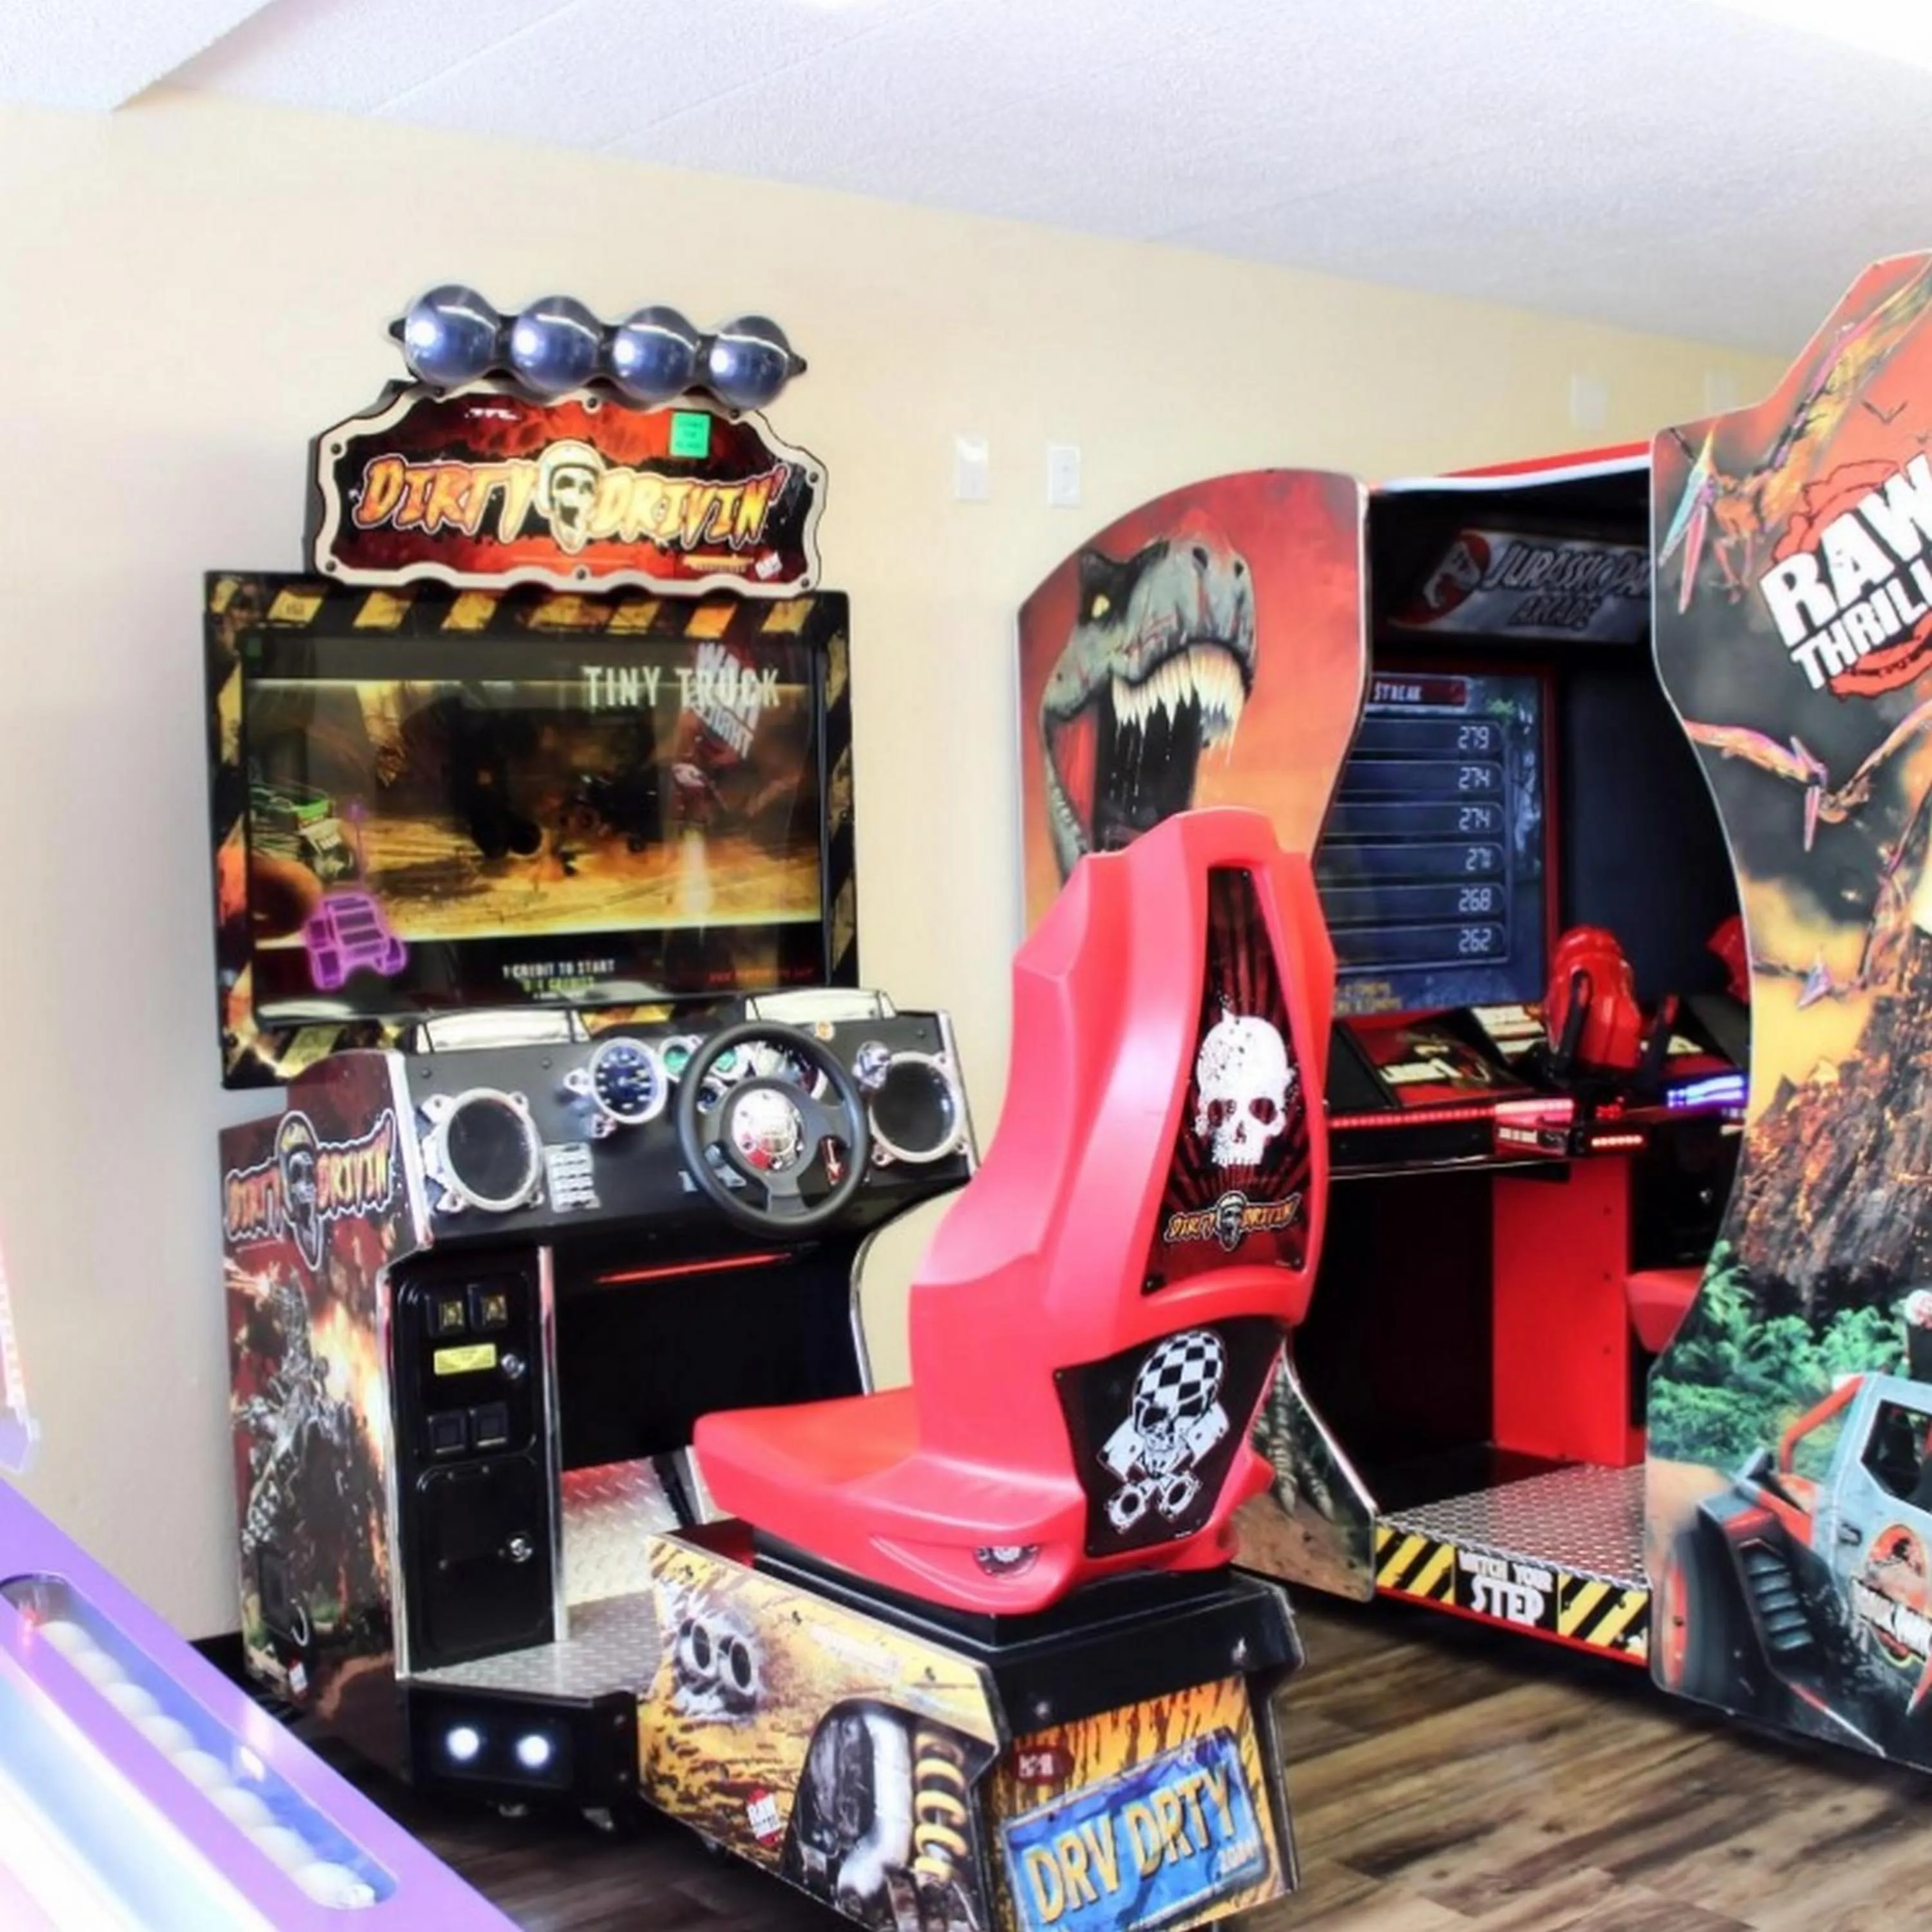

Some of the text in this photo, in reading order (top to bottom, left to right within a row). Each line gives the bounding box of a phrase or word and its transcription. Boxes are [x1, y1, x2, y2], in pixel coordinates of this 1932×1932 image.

[354, 456, 537, 542] DIRTY
[1760, 452, 1932, 649] RAW
[583, 665, 781, 708] TINY TRUCK
[1458, 726, 1490, 750] 279
[1459, 767, 1490, 790] 274
[1459, 808, 1490, 831] 274
[1459, 888, 1492, 912] 268
[1459, 928, 1492, 952] 262
[1470, 1573, 1544, 1627] STEP
[1023, 1763, 1235, 1923] DRV DRTY
